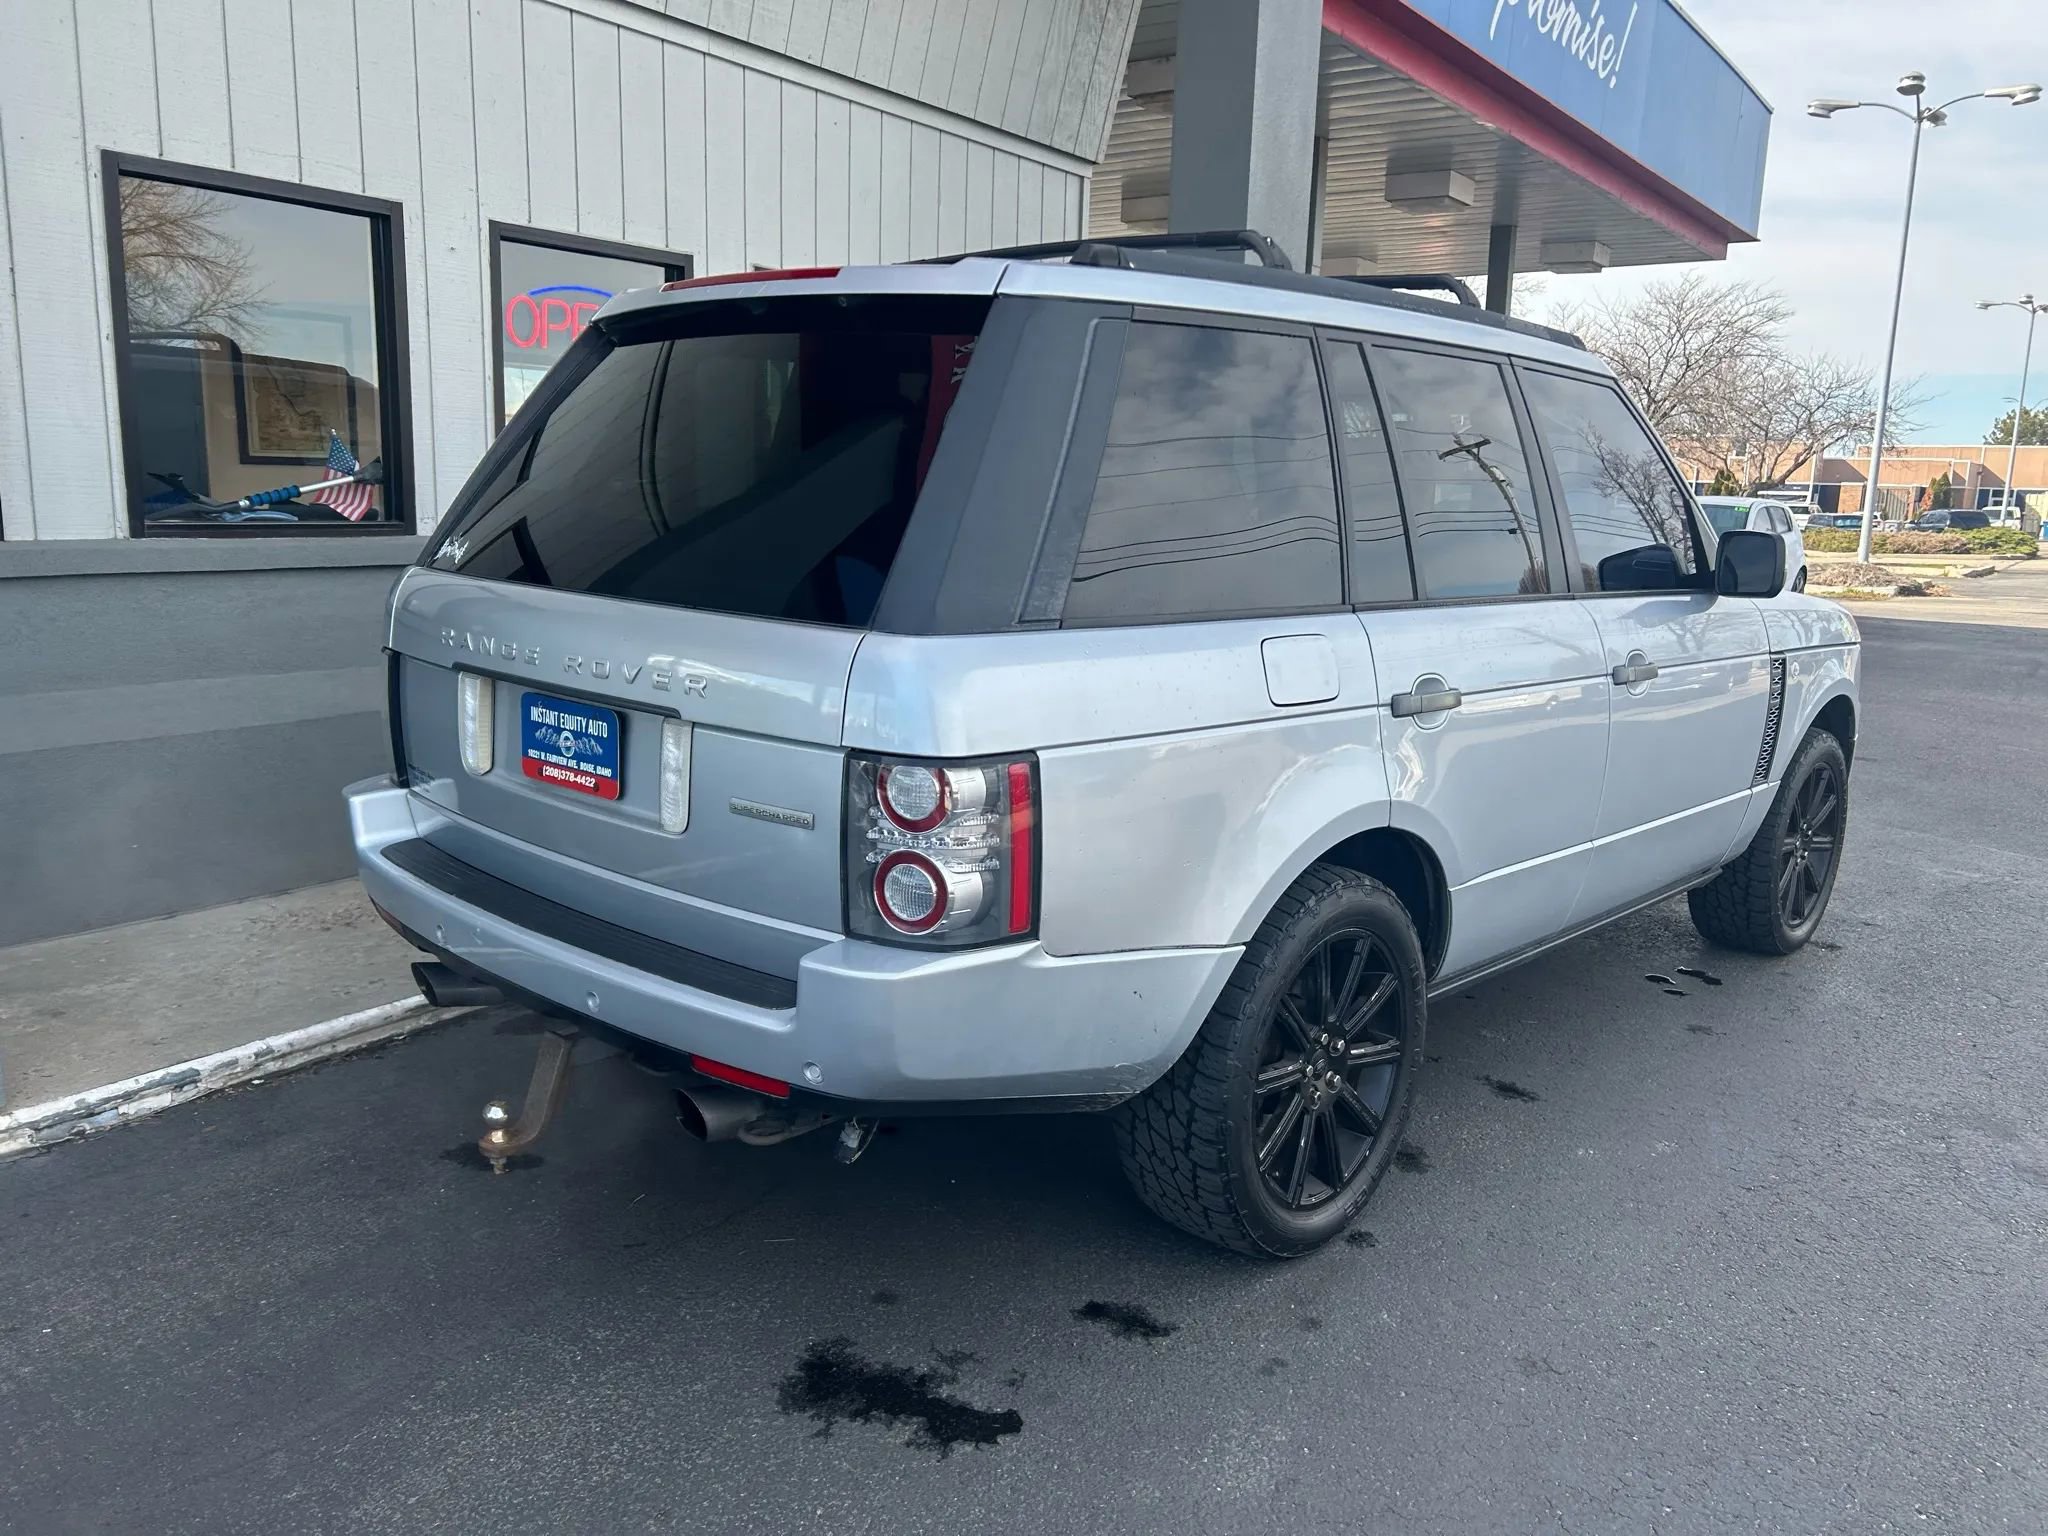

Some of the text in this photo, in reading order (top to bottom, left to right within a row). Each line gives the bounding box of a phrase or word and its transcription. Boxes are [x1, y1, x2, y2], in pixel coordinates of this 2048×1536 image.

[505, 293, 600, 348] OPE
[439, 628, 708, 699] RANGE ROVER
[530, 706, 608, 738] INSTANT EQUITY AUTO
[543, 765, 595, 787] (208)378-4422
[546, 752, 568, 766] FAIRVIEW
[596, 765, 612, 778] IDAHO
[730, 803, 810, 826] SUPERCHARGED
